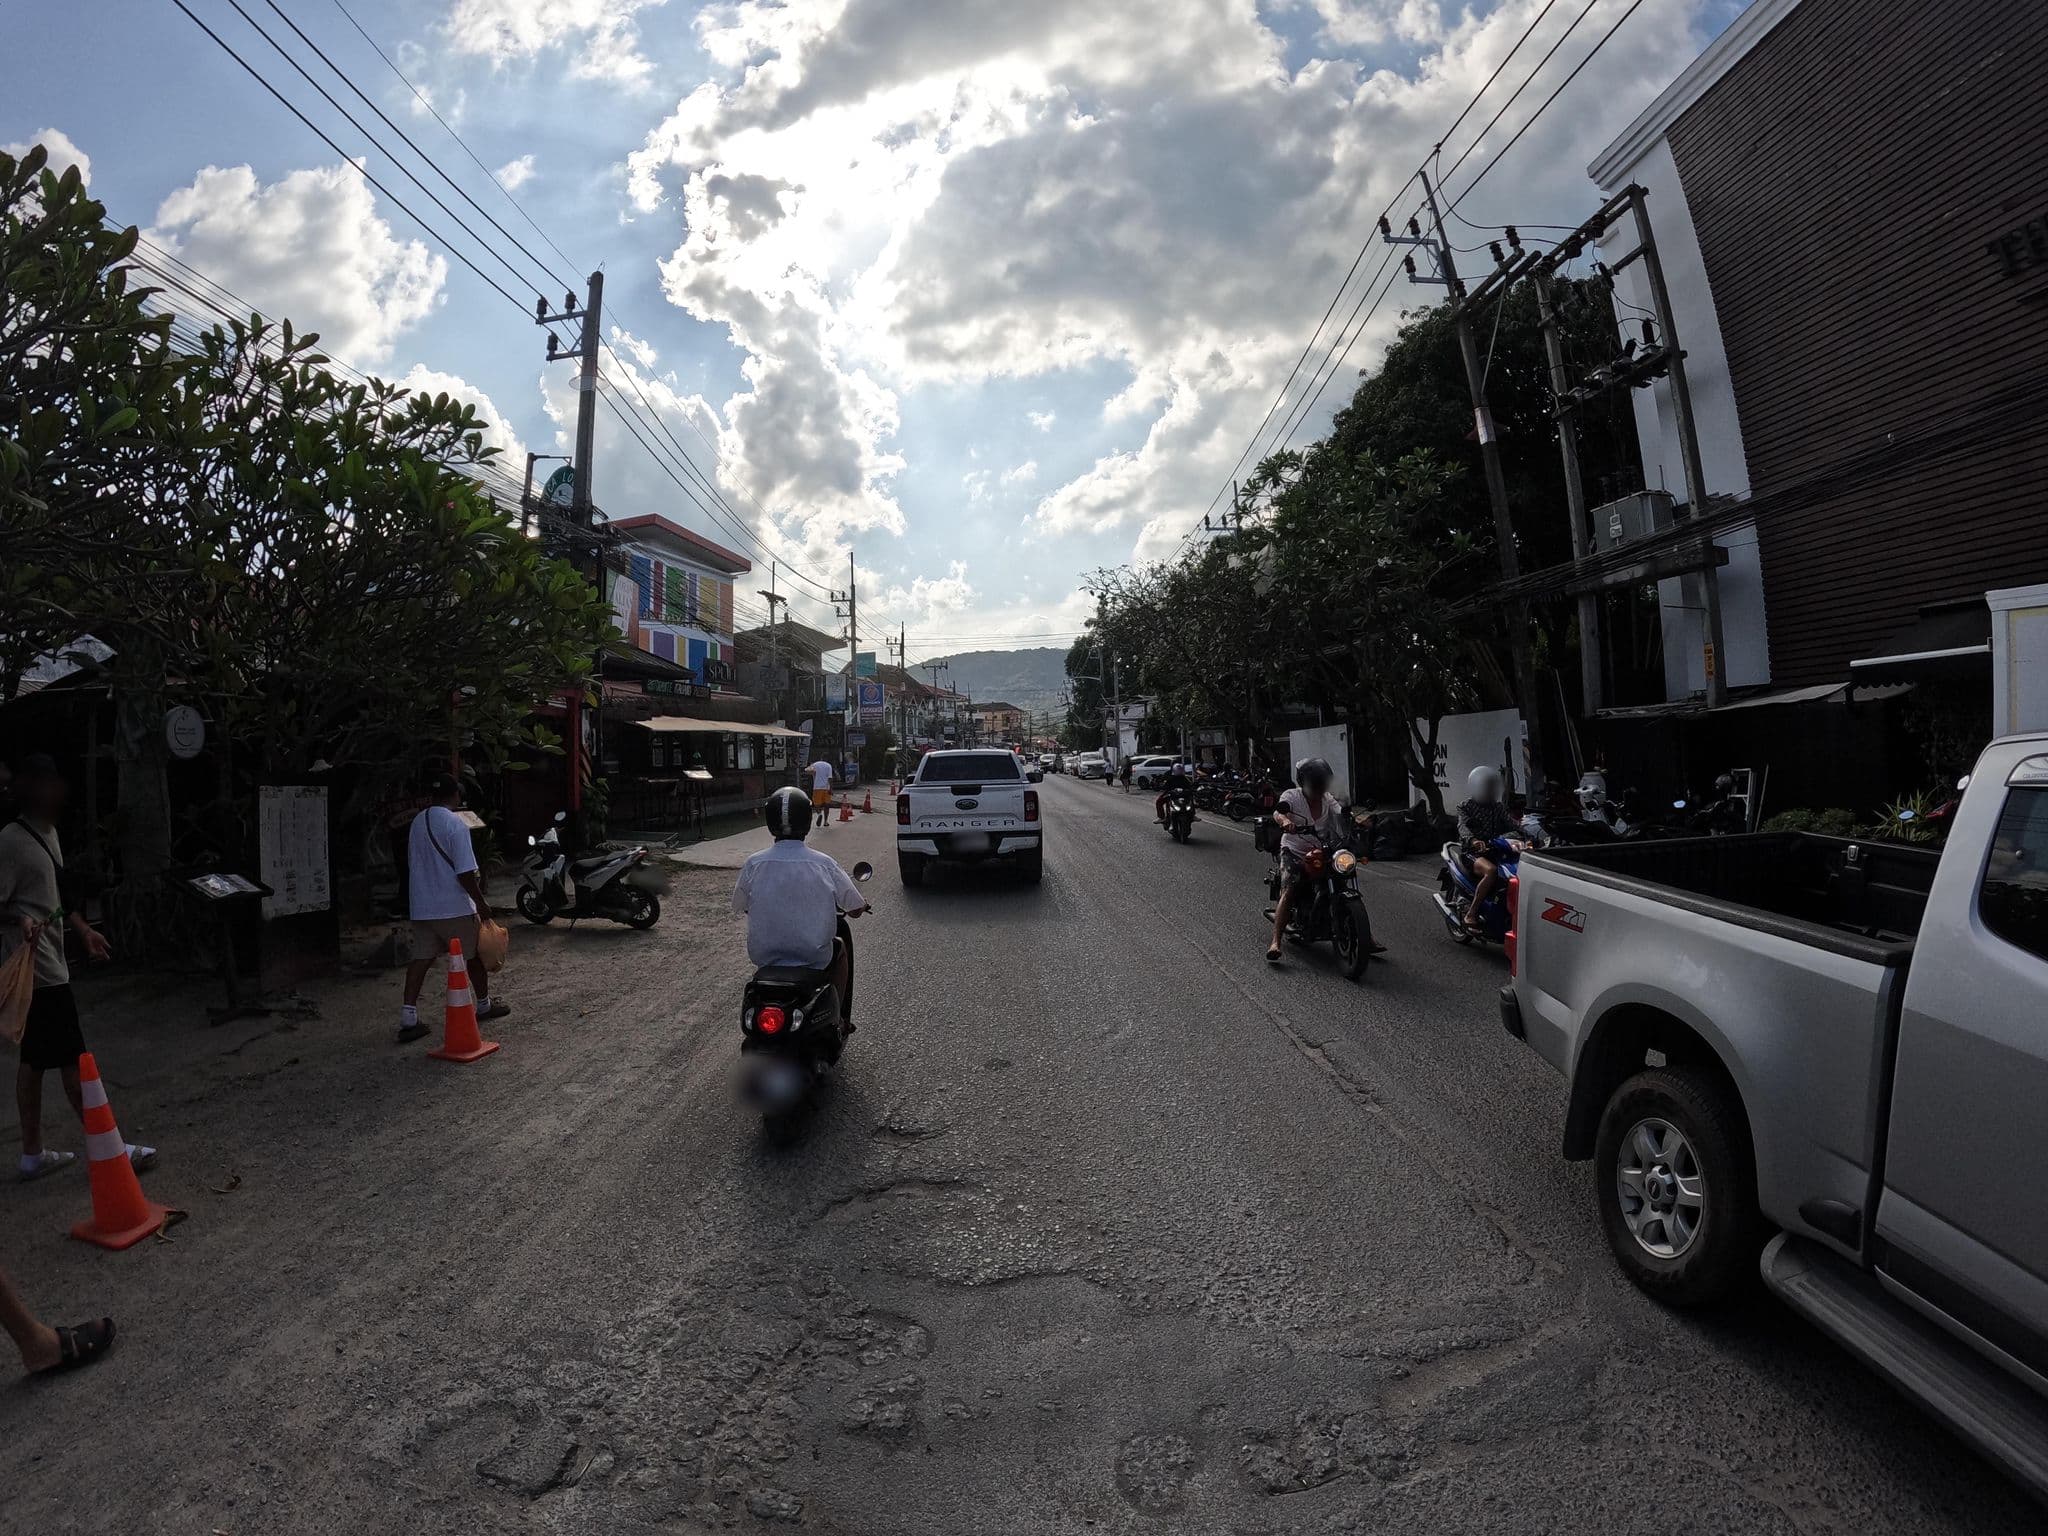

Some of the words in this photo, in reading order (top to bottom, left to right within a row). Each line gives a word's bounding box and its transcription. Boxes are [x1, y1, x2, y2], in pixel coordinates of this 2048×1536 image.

[1434, 744, 1447, 758] AN
[1434, 762, 1446, 777] OK
[920, 819, 1015, 828] RANGER
